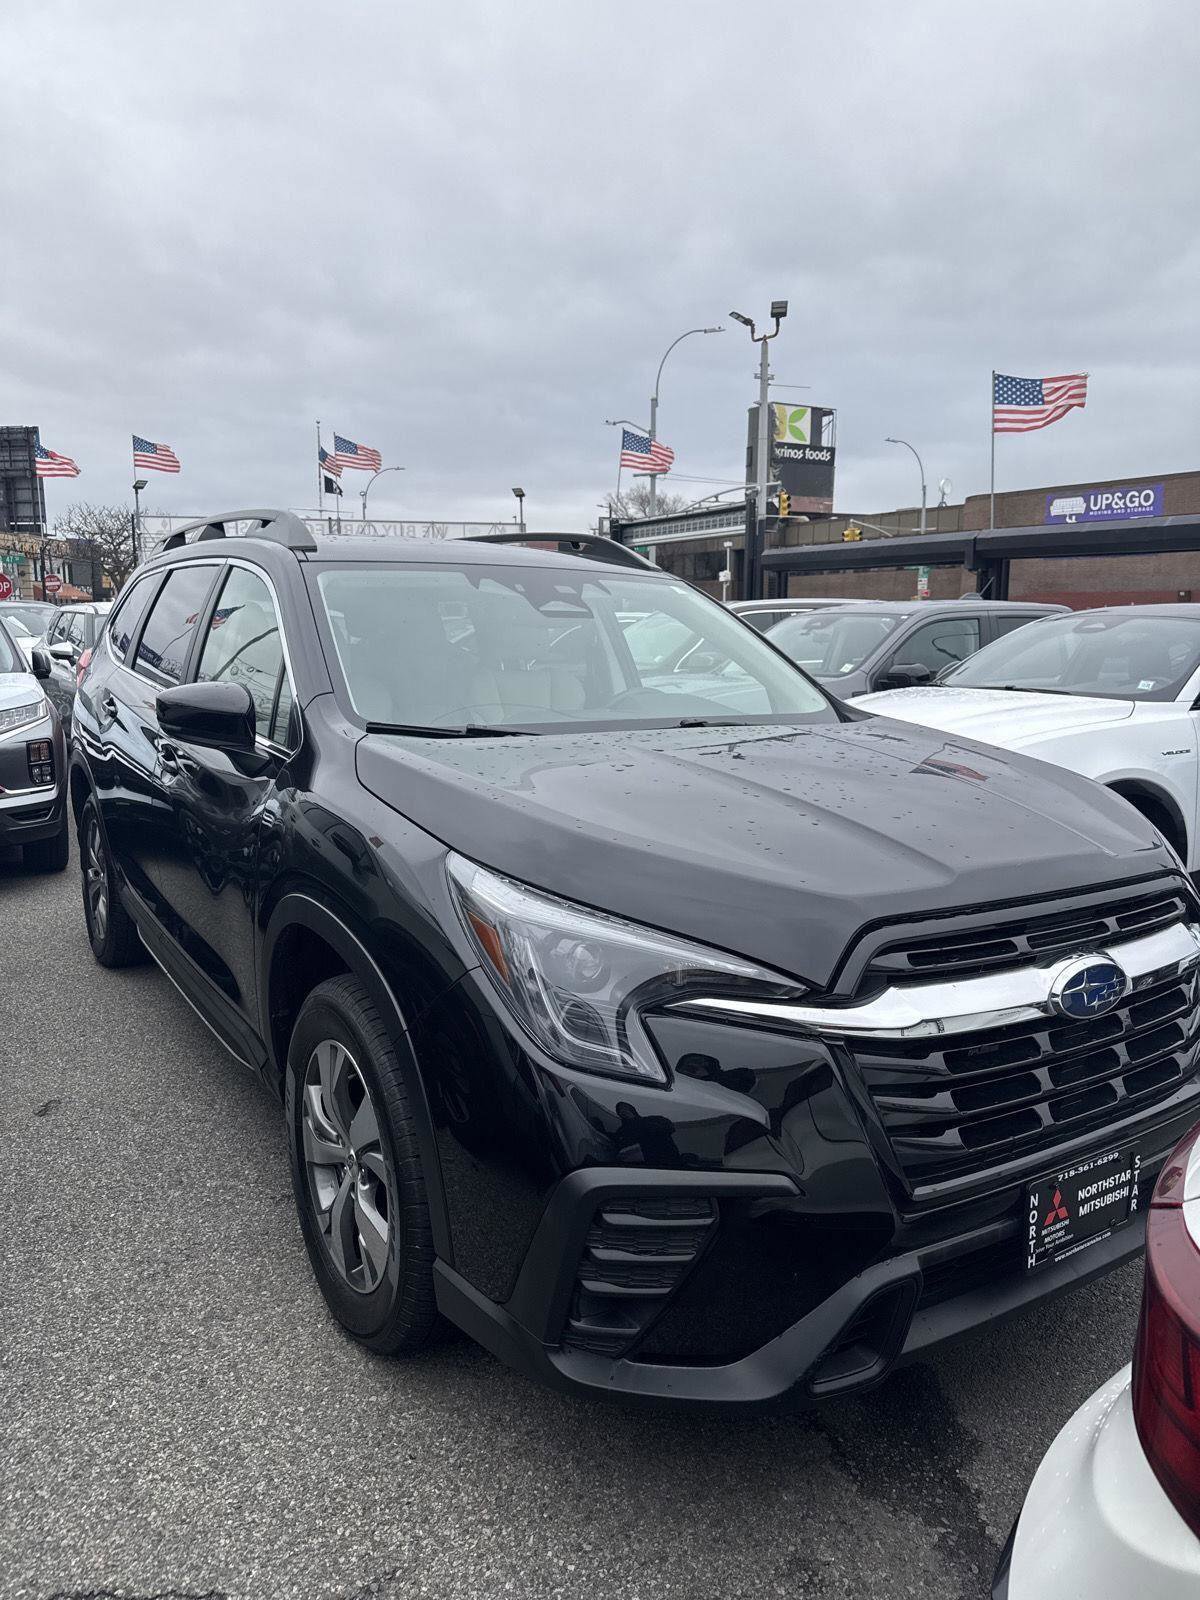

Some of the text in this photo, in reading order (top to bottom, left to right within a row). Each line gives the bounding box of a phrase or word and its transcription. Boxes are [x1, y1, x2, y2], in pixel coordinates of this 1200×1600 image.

[805, 448, 831, 461] foods
[1090, 489, 1155, 510] UP&GO
[1058, 1152, 1119, 1181] 718-361-6299
[1077, 1169, 1131, 1201] NORTHSTAR
[1078, 1186, 1129, 1217] MITSUBISHI
